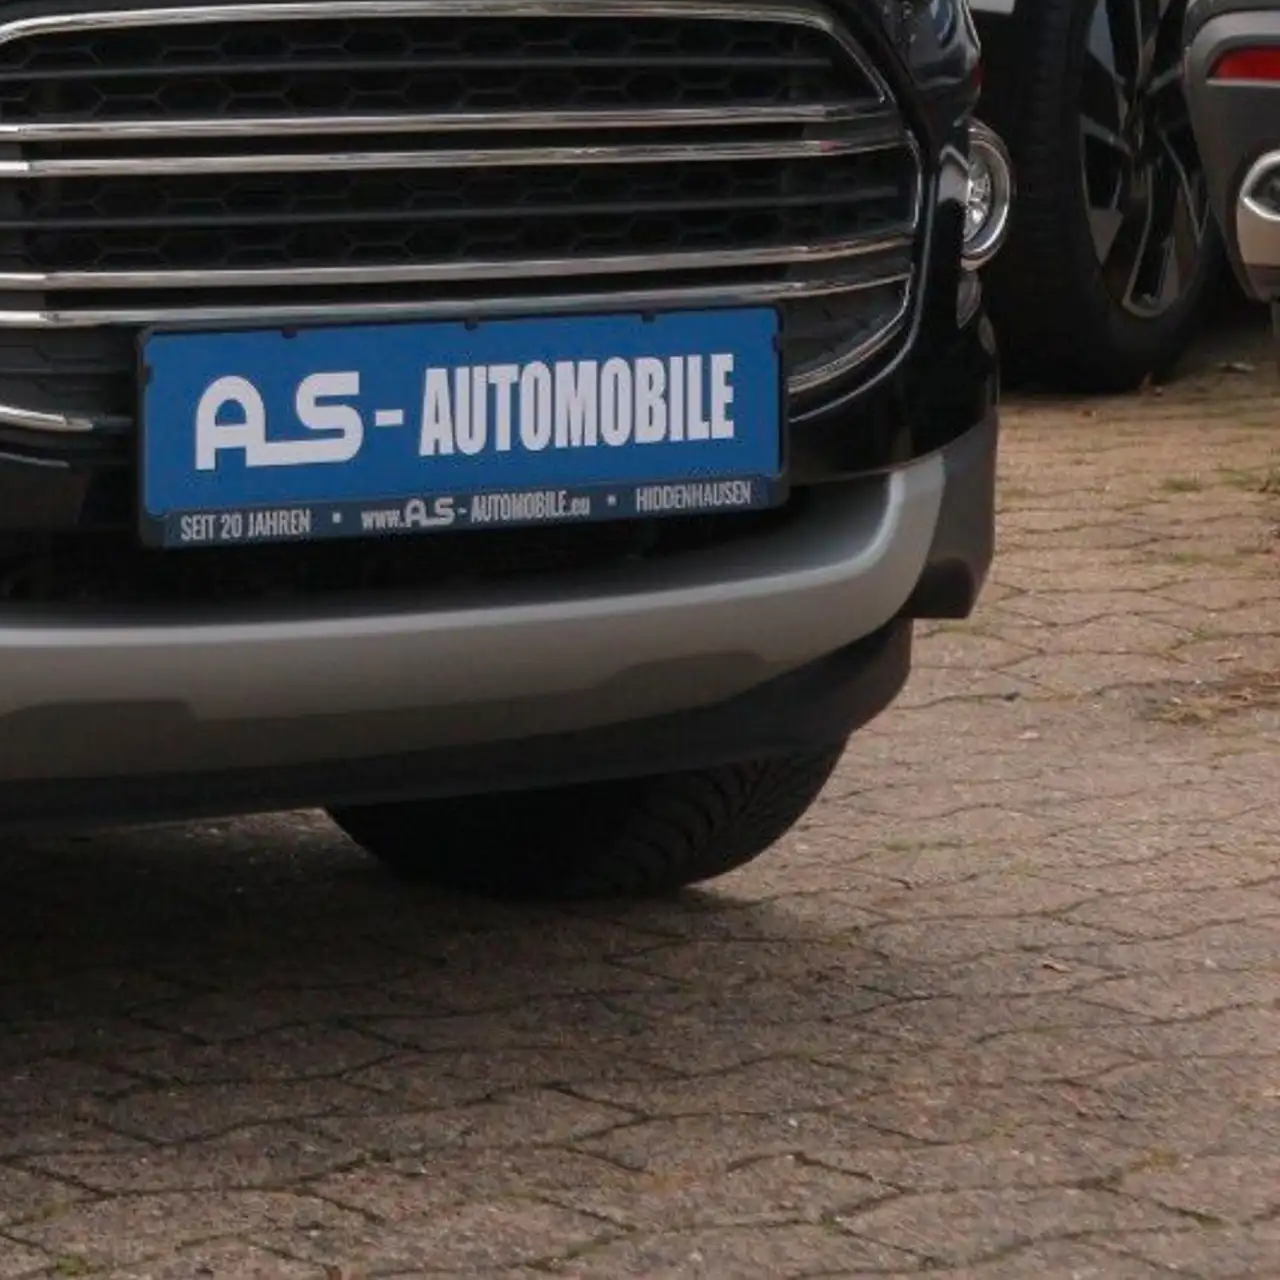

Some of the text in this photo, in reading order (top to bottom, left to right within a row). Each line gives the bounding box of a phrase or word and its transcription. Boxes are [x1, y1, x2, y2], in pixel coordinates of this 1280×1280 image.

[194, 352, 736, 471] AS-AUTOMOBILE
[180, 513, 216, 541] SEIT
[220, 513, 242, 539] 20
[248, 508, 312, 537] JAHREN
[636, 480, 752, 512] HIDDENHAUSEN
